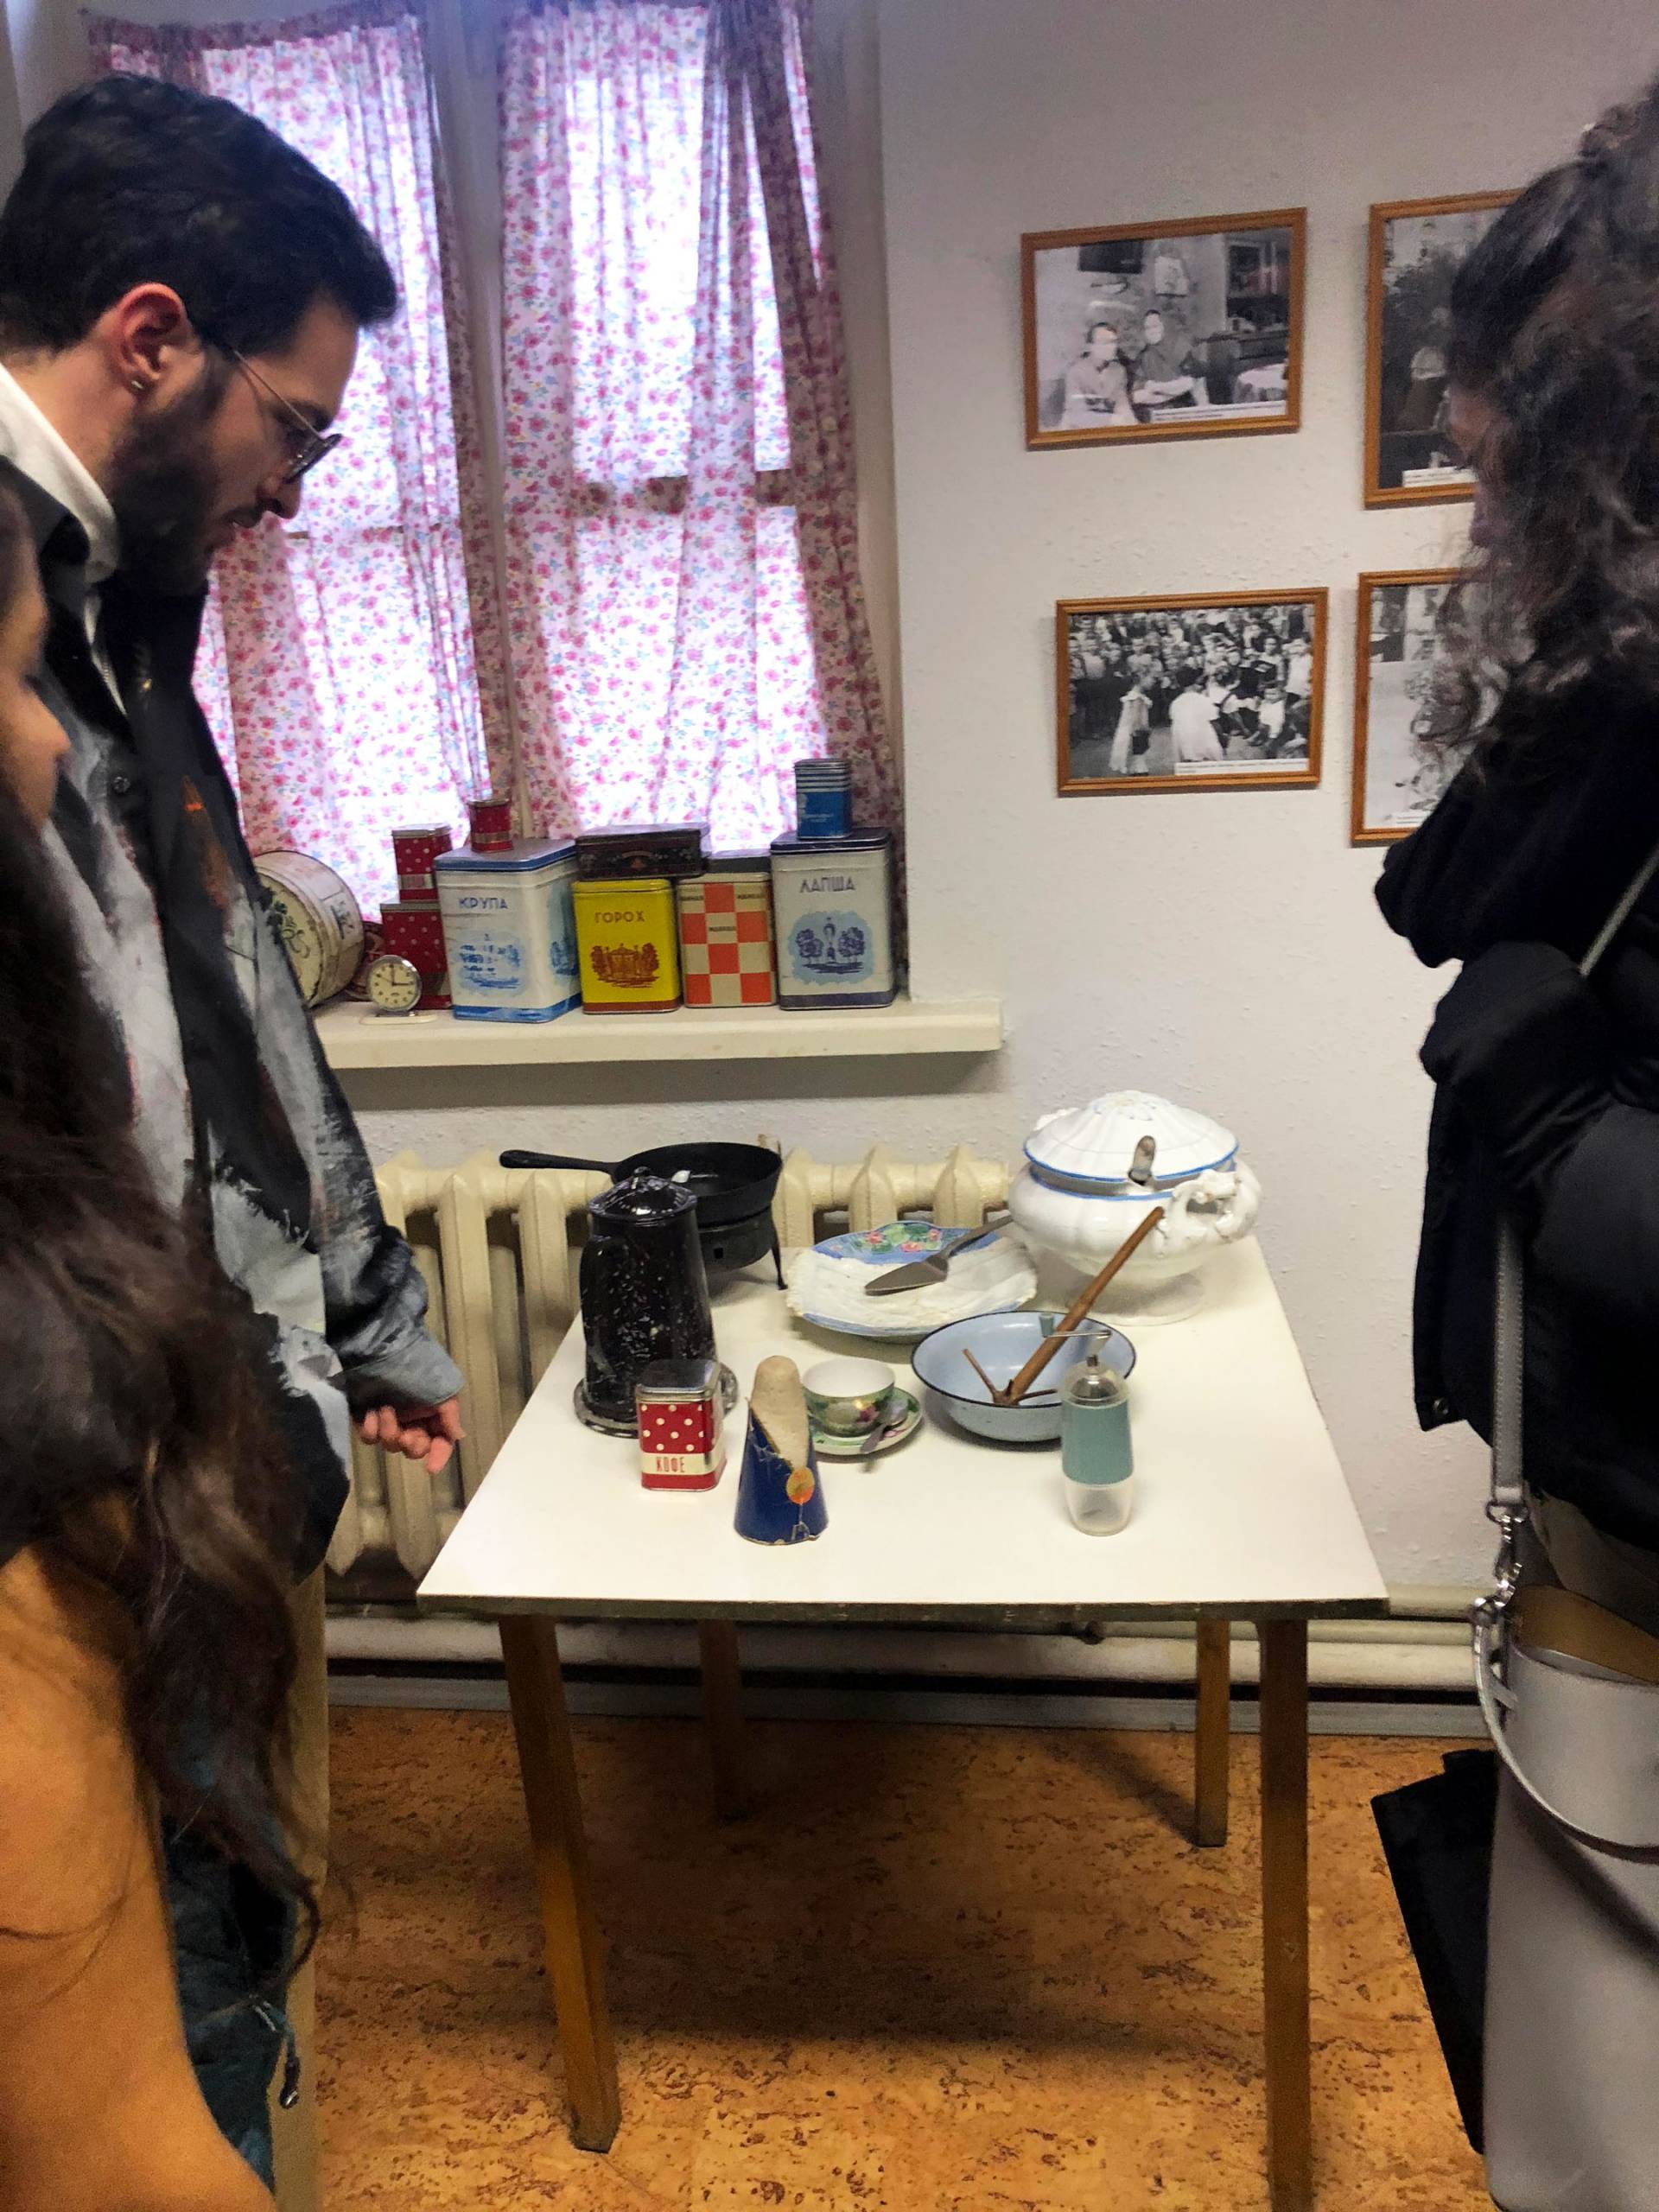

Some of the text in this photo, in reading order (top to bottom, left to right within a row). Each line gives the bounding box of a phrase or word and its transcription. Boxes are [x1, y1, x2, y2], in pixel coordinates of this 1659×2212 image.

[799, 876, 855, 893] ЛАПША
[459, 897, 508, 910] КРУПА
[594, 912, 645, 924] ГОРОХ
[656, 1456, 684, 1472] КОФЕ
